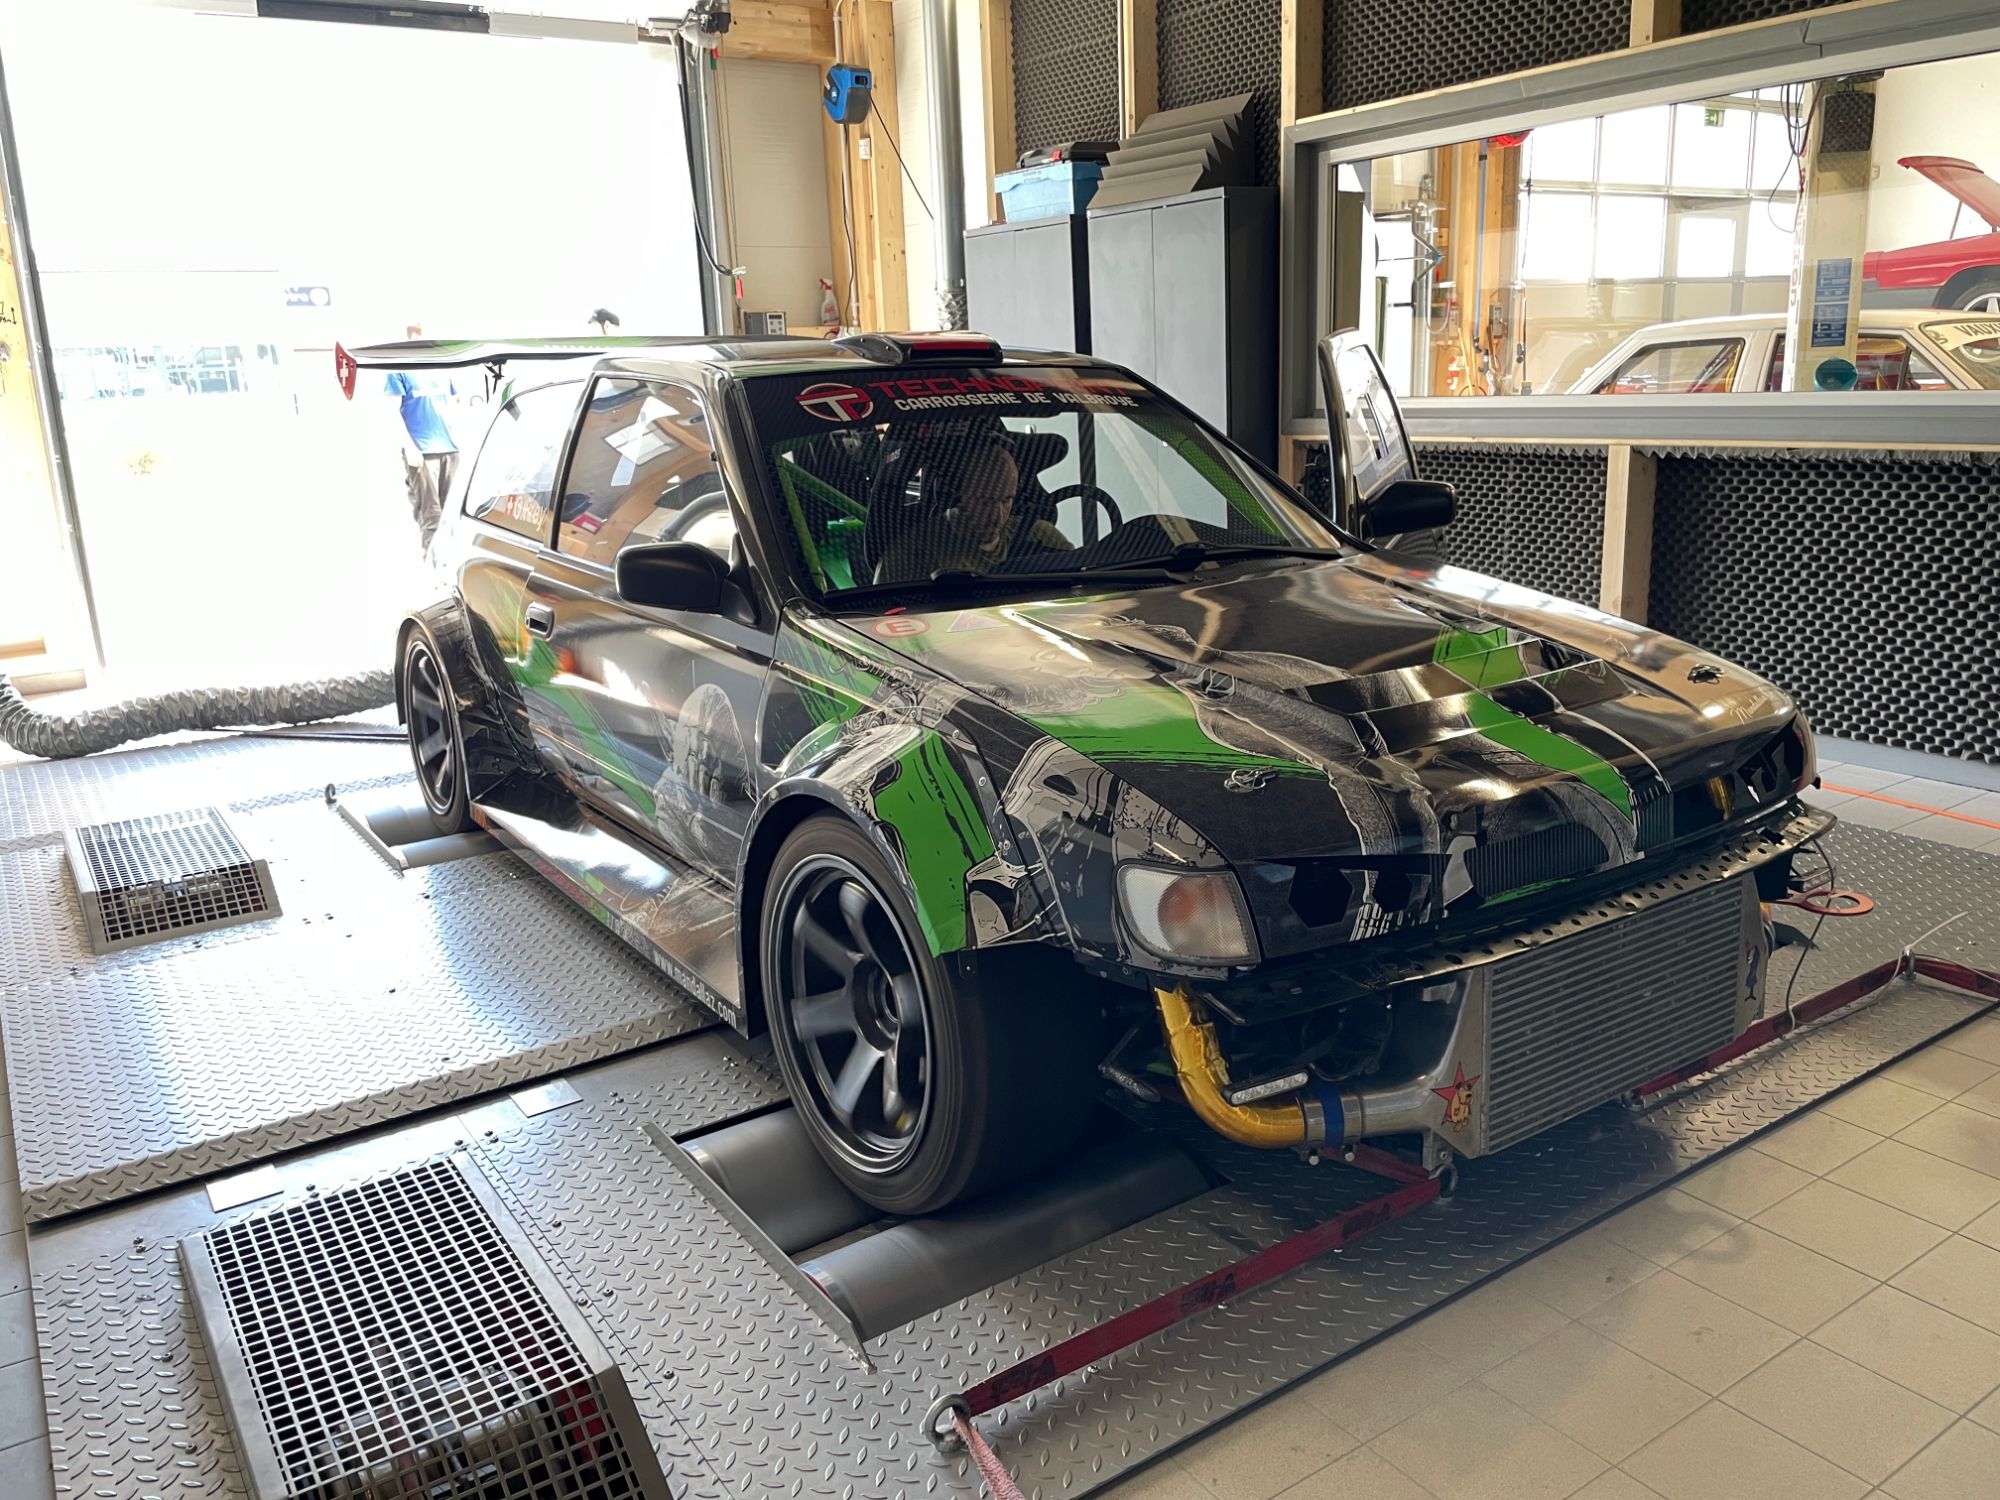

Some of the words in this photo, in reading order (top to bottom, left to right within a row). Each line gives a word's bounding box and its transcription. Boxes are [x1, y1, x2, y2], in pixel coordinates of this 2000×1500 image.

[894, 392, 1022, 411] CARROSSERIE
[1023, 392, 1052, 404] DE
[1052, 392, 1140, 408] VALBROYE
